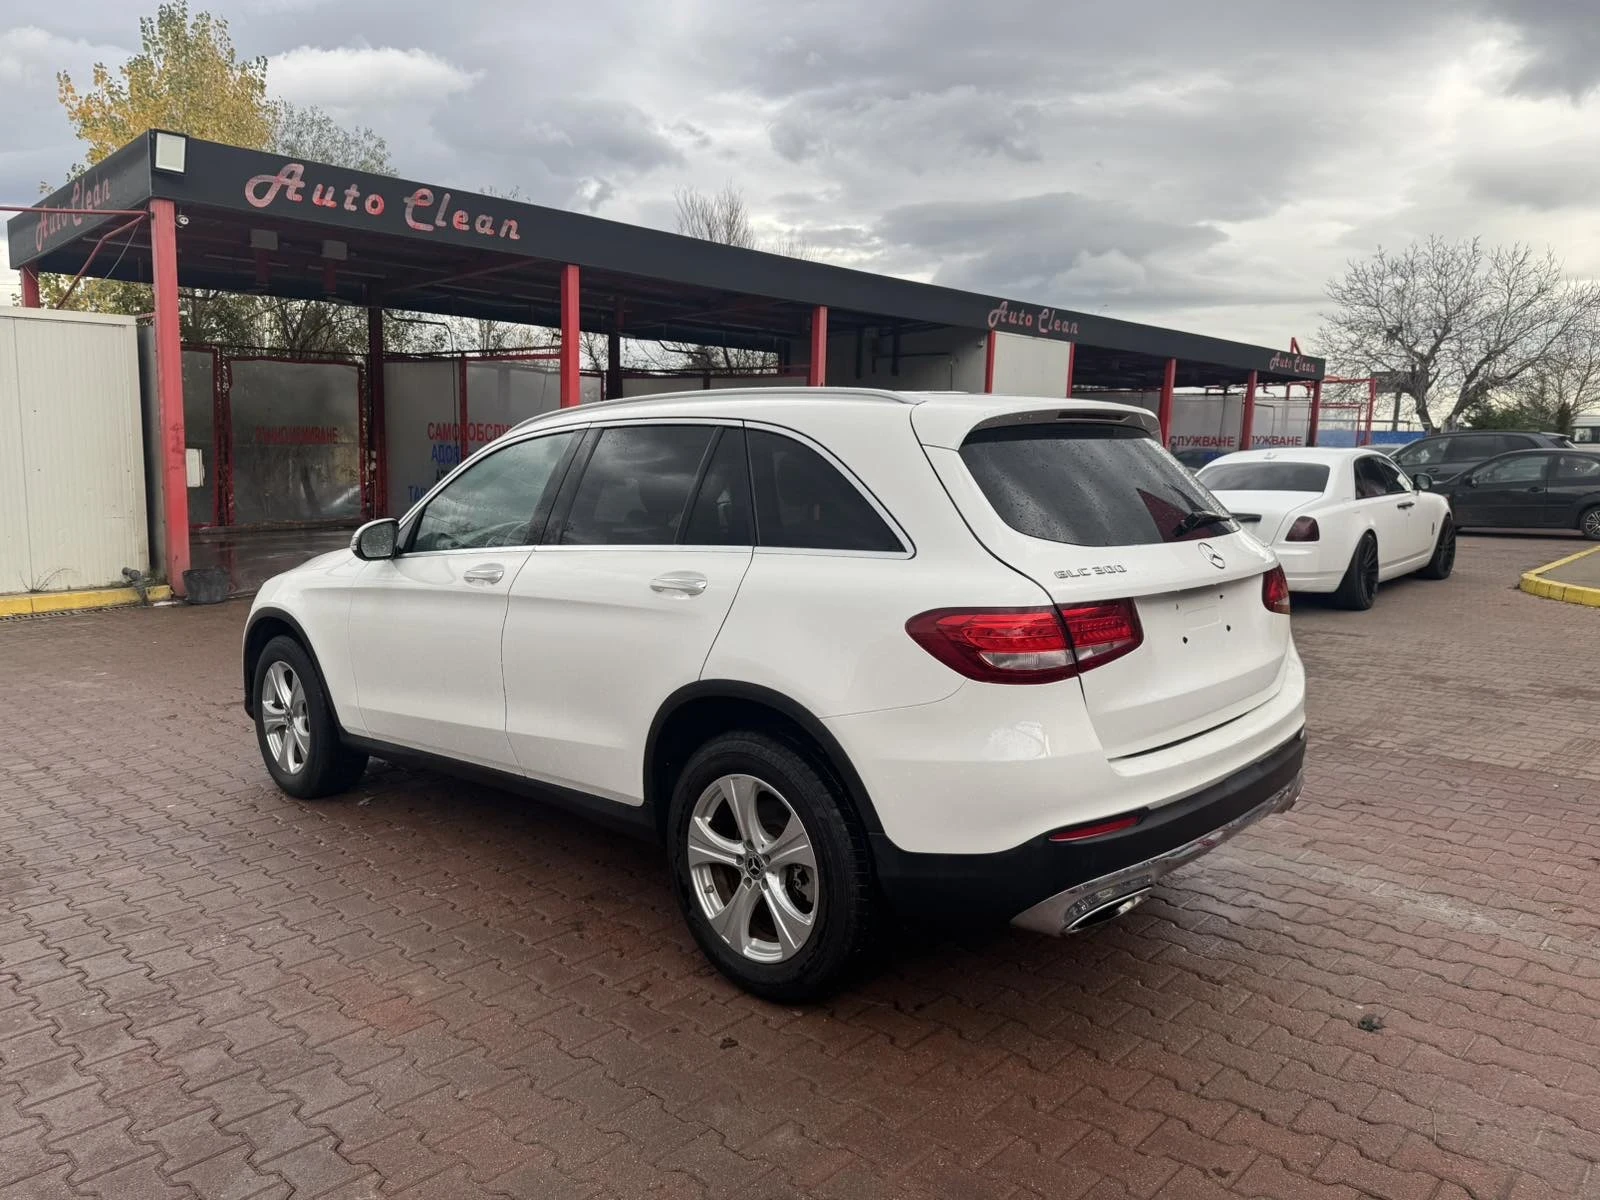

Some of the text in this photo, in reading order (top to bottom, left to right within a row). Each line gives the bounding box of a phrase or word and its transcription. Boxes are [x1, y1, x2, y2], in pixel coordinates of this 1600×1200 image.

[71, 177, 111, 227] Clean
[244, 162, 521, 240] Auto Clean
[987, 300, 1079, 335] Auto Clean
[1269, 351, 1317, 373] Auto Clean
[1053, 564, 1128, 579] GLC 300
